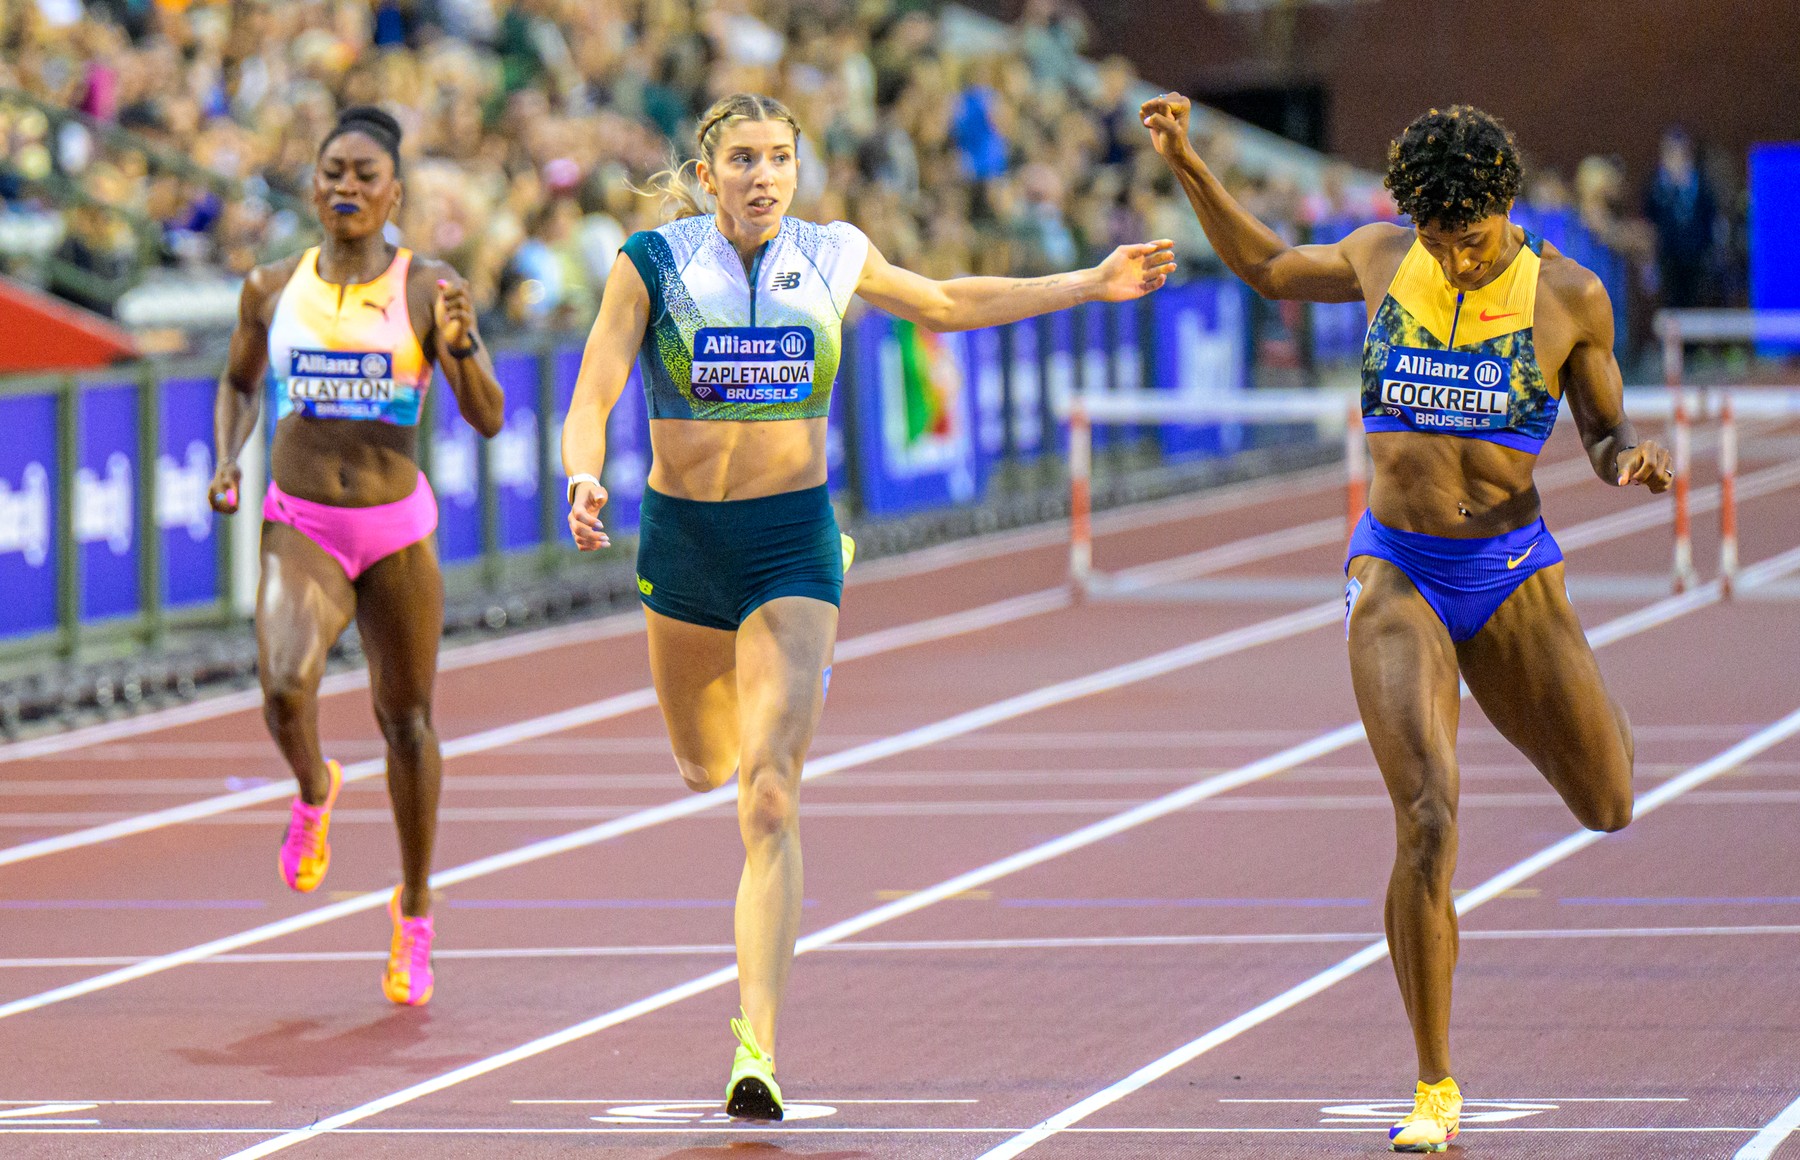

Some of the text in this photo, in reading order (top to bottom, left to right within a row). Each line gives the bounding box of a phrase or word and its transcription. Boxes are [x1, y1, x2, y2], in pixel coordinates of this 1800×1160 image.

[703, 334, 776, 355] Allianz
[297, 353, 360, 375] Allianz
[697, 362, 810, 384] ZAPLETALOVÁ
[1395, 354, 1470, 381] Allianz
[292, 379, 389, 399] CLAYTON
[726, 388, 798, 401] BRUSSELS
[1386, 382, 1502, 414] COCKRELL
[1415, 412, 1491, 428] BRUSSELS
